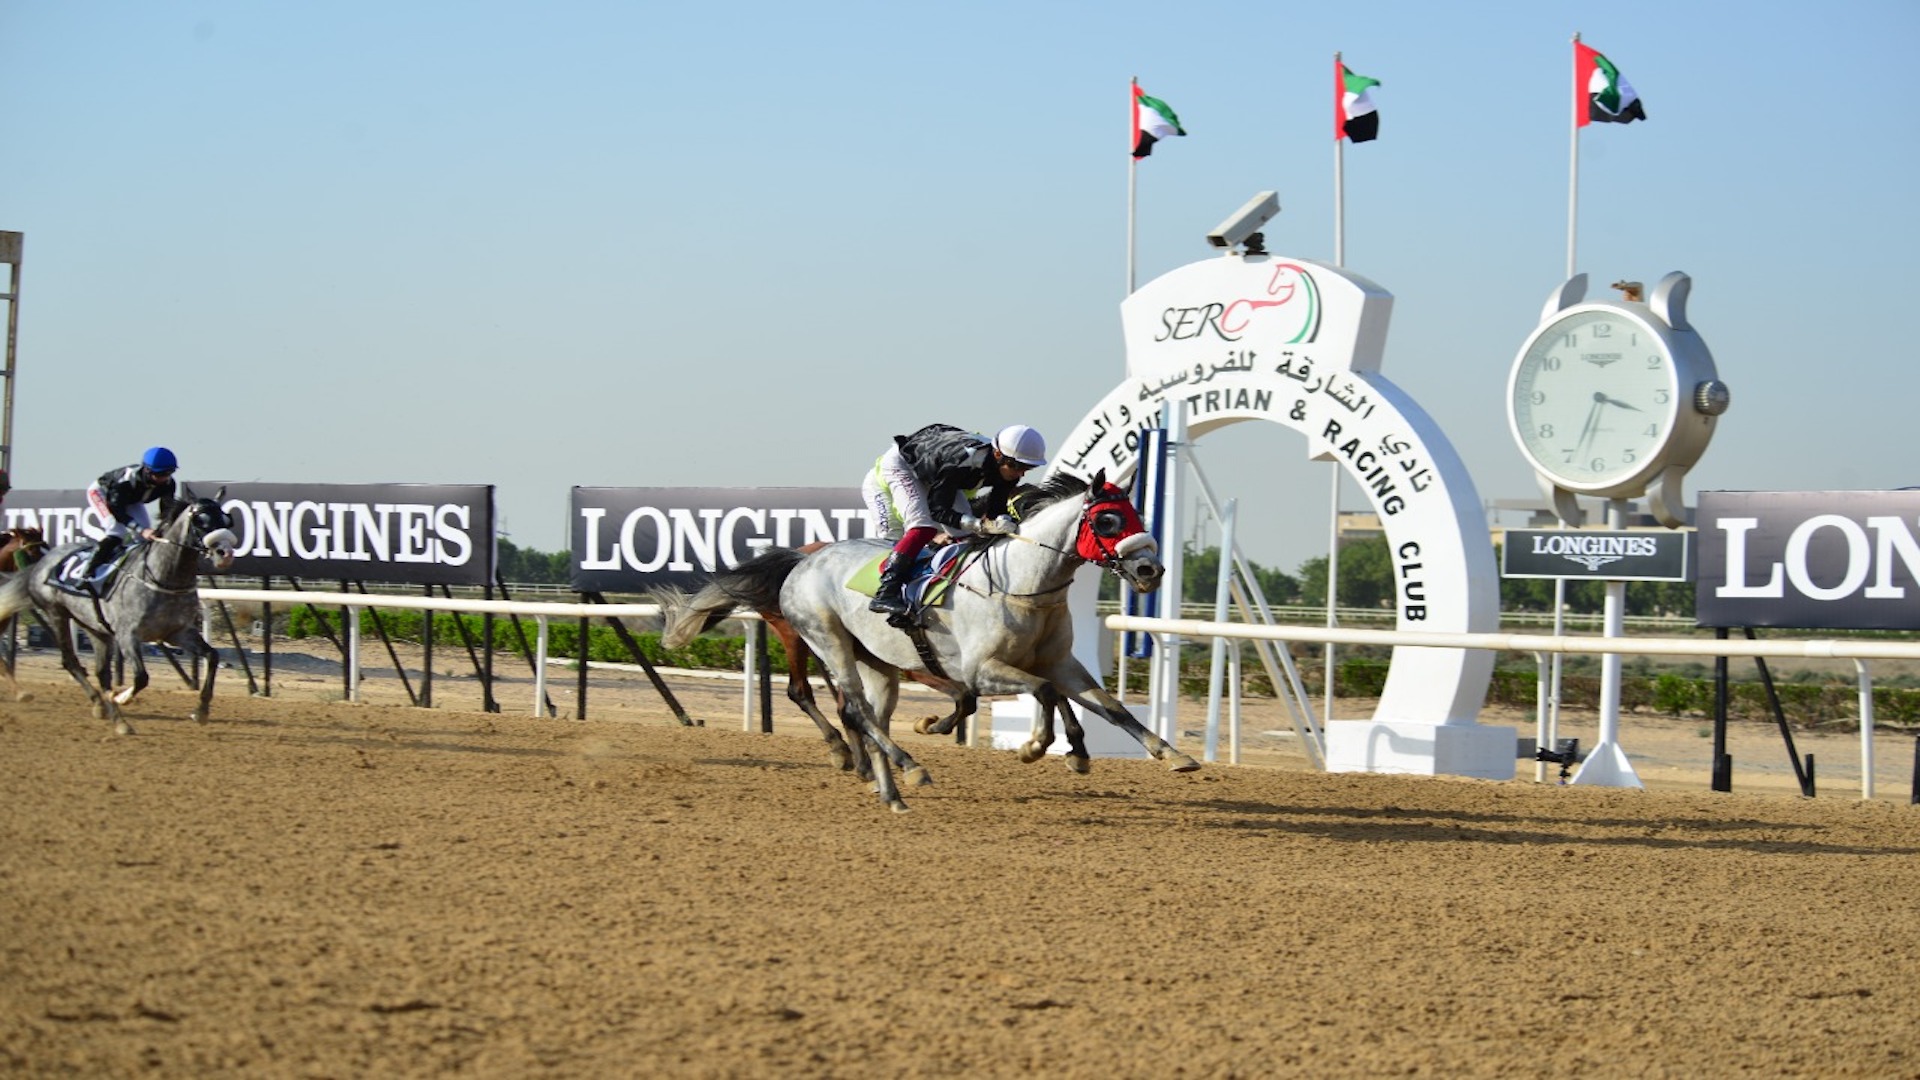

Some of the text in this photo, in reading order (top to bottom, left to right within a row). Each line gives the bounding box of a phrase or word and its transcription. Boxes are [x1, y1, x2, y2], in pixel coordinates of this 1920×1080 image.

[1154, 299, 1252, 342] SERC
[1592, 323, 1612, 338] 12
[1564, 333, 1577, 348] 11
[1542, 357, 1561, 372] 10
[1647, 355, 1661, 370] 2
[1275, 351, 1376, 420] الشارقة
[1531, 391, 1545, 406] 9
[1655, 389, 1669, 404] 3
[1539, 424, 1554, 438] 8
[1643, 423, 1658, 438] 4
[1378, 433, 1432, 493] نادي
[1561, 448, 1574, 463] 7
[1622, 448, 1636, 463] 5
[1591, 457, 1605, 472] 6
[1109, 387, 1427, 622] EQUTRIAN & RACING CLUB
[221, 499, 472, 566] ONGINES
[580, 506, 878, 573] LONGIN
[1531, 535, 1657, 556] LONGINES
